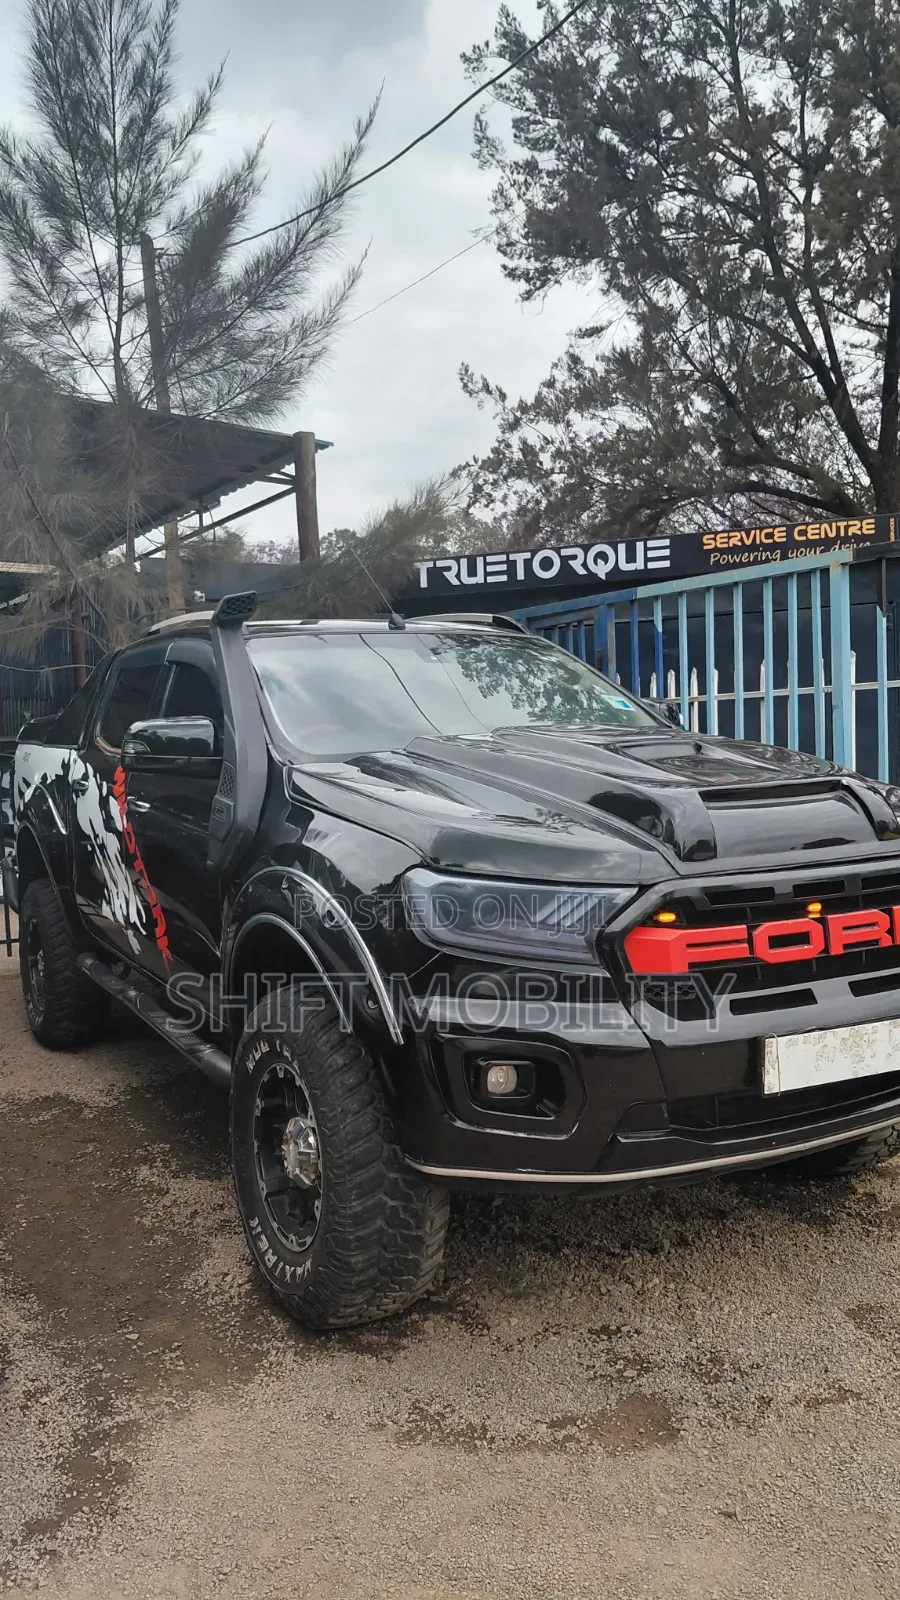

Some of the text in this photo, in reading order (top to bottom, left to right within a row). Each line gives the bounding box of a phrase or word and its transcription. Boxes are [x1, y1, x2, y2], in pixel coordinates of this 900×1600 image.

[702, 518, 876, 550] SERVICE CENTRE
[710, 546, 781, 564] Powering
[788, 545, 825, 560] your
[414, 538, 671, 589] TRUETORQUE
[624, 905, 900, 974] FOR
